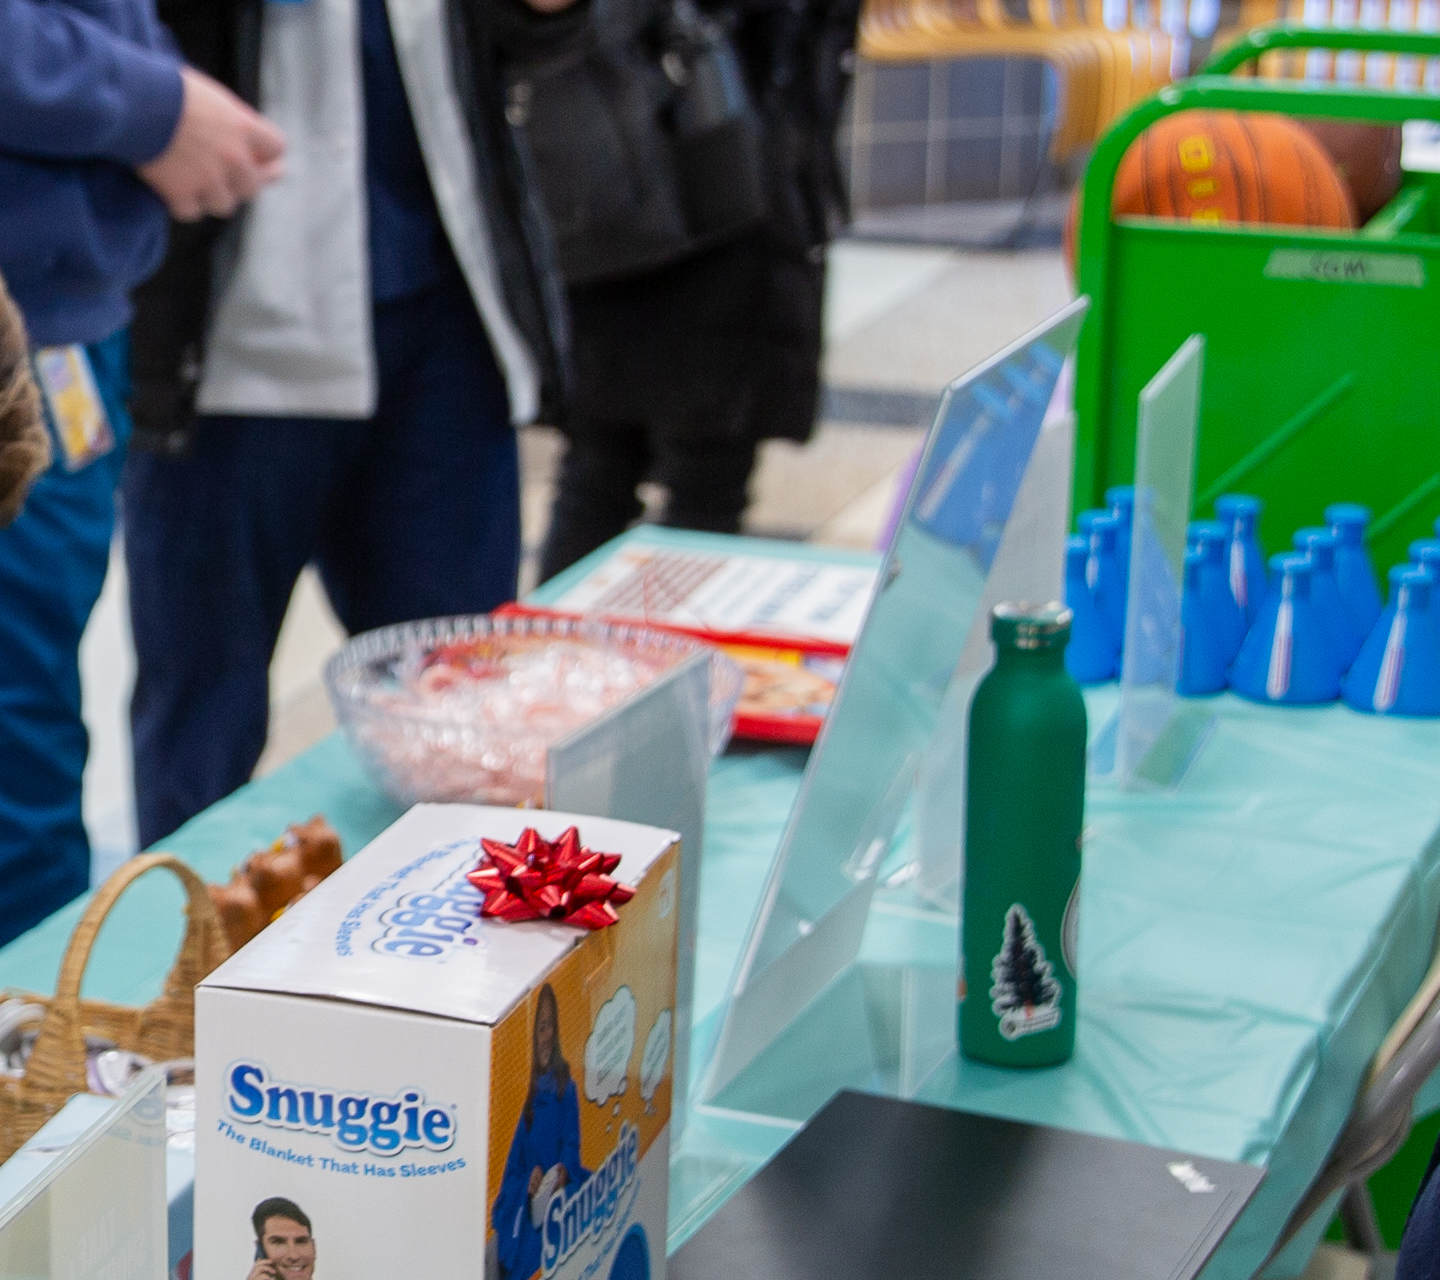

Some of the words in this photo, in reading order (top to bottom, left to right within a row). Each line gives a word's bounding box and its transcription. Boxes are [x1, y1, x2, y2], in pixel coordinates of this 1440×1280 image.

[216, 1119, 246, 1145] The
[248, 1136, 314, 1168] Blanket
[319, 1156, 359, 1176] That
[363, 1165, 396, 1178] Has
[399, 1157, 467, 1178] Sleeves
[229, 1065, 451, 1151] Snuggie
[543, 1123, 639, 1271] Snuggie
